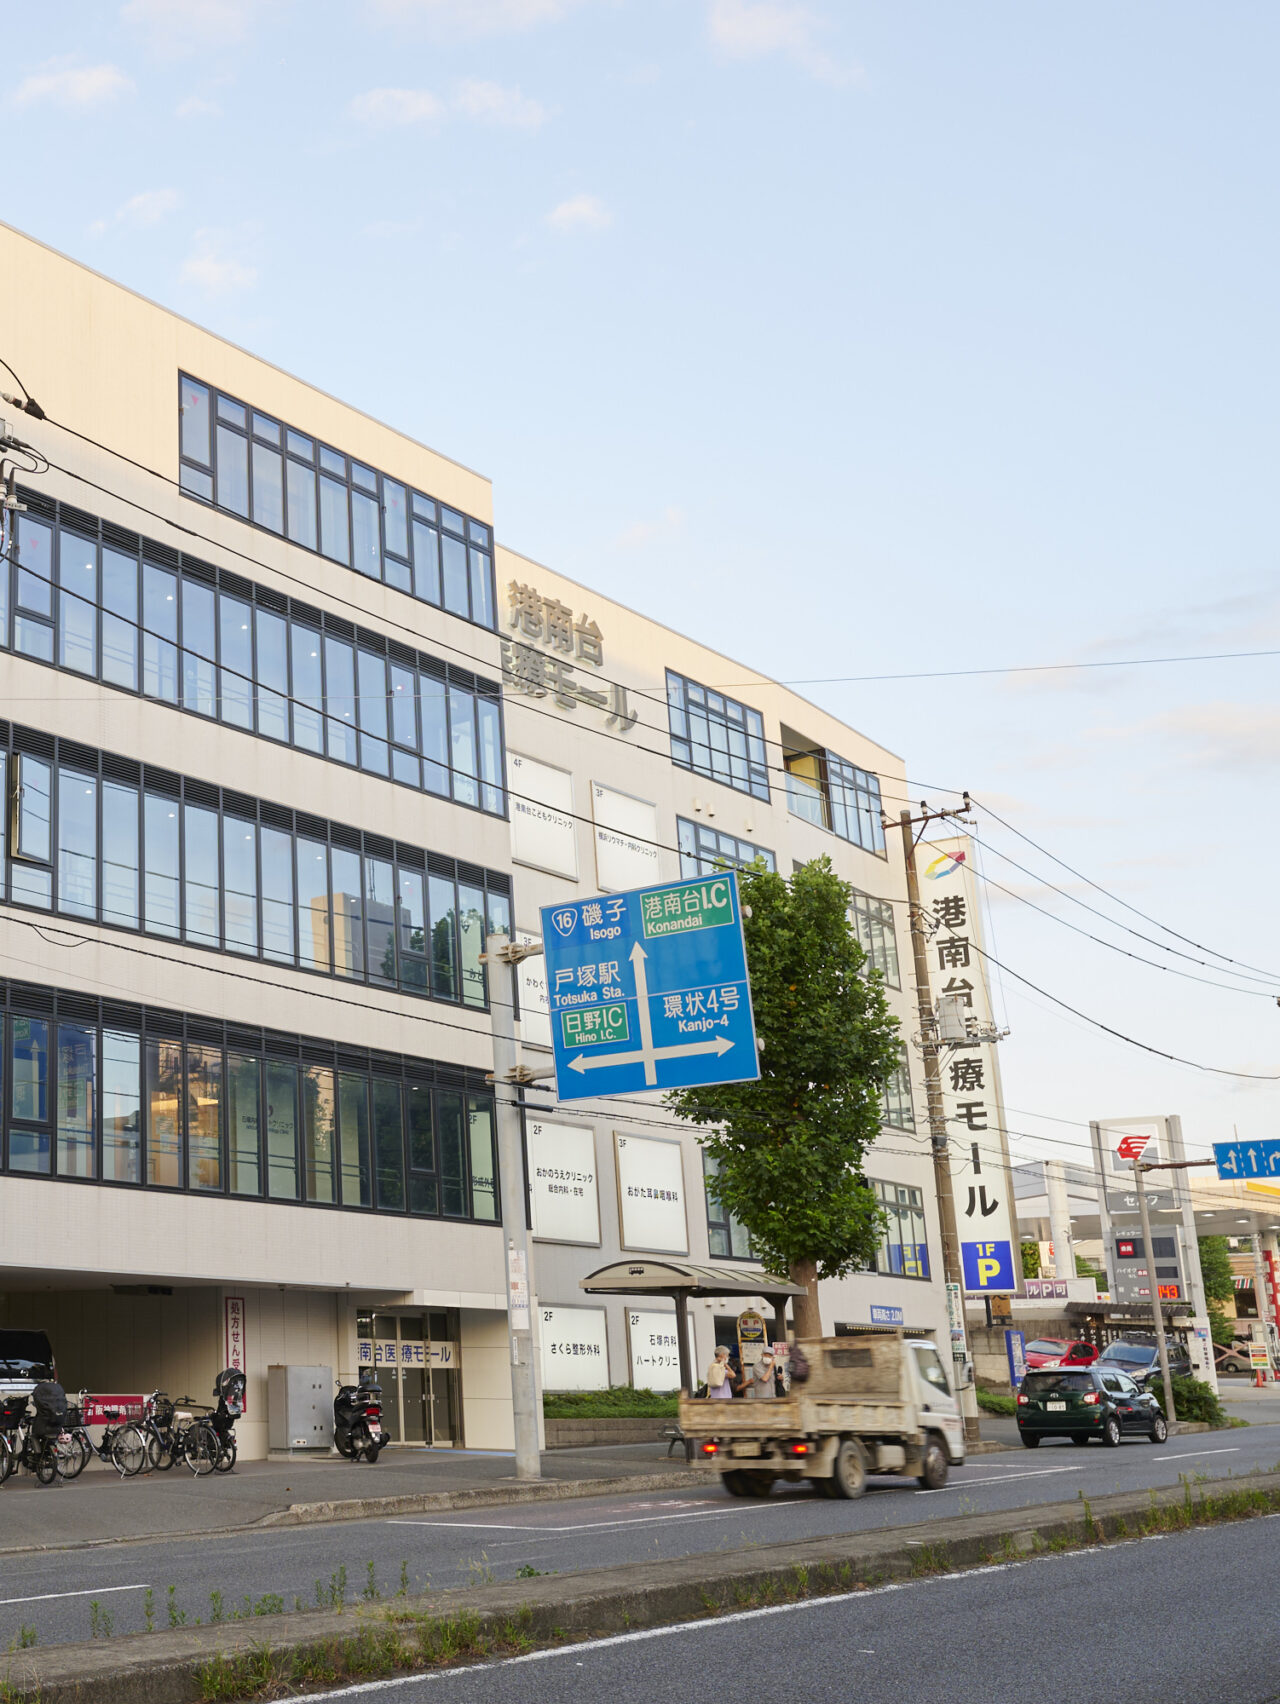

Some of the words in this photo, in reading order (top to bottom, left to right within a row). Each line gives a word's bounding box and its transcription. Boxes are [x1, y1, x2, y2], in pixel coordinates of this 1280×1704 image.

[507, 578, 604, 667] 港南台
[513, 758, 522, 768] 4F
[581, 898, 627, 928] 磯子
[556, 914, 573, 930] 16
[647, 914, 703, 935] Konandai
[590, 926, 622, 941] Isogo
[554, 960, 622, 993] 戸塚駅
[553, 990, 598, 1008] Totsuka
[602, 986, 625, 1001] Sta.
[663, 986, 741, 1020] 環状4号
[566, 1006, 624, 1034] 日野IC
[678, 1013, 729, 1034] Kanjo-4
[575, 1032, 597, 1044] Hino
[601, 1028, 617, 1041] I.C.
[533, 1124, 543, 1136] 2F
[536, 1167, 594, 1184] おかのうえクリニック
[1123, 1194, 1159, 1208] セフ
[976, 1243, 995, 1257] 1F
[977, 1258, 1001, 1287] P
[1157, 1284, 1179, 1299] 143
[543, 1311, 553, 1322] 2F
[631, 1315, 640, 1326] 2F
[649, 1334, 677, 1347] 石塚内科
[357, 1343, 451, 1363] 南台医療モール
[550, 1342, 600, 1356] さくら整形外科
